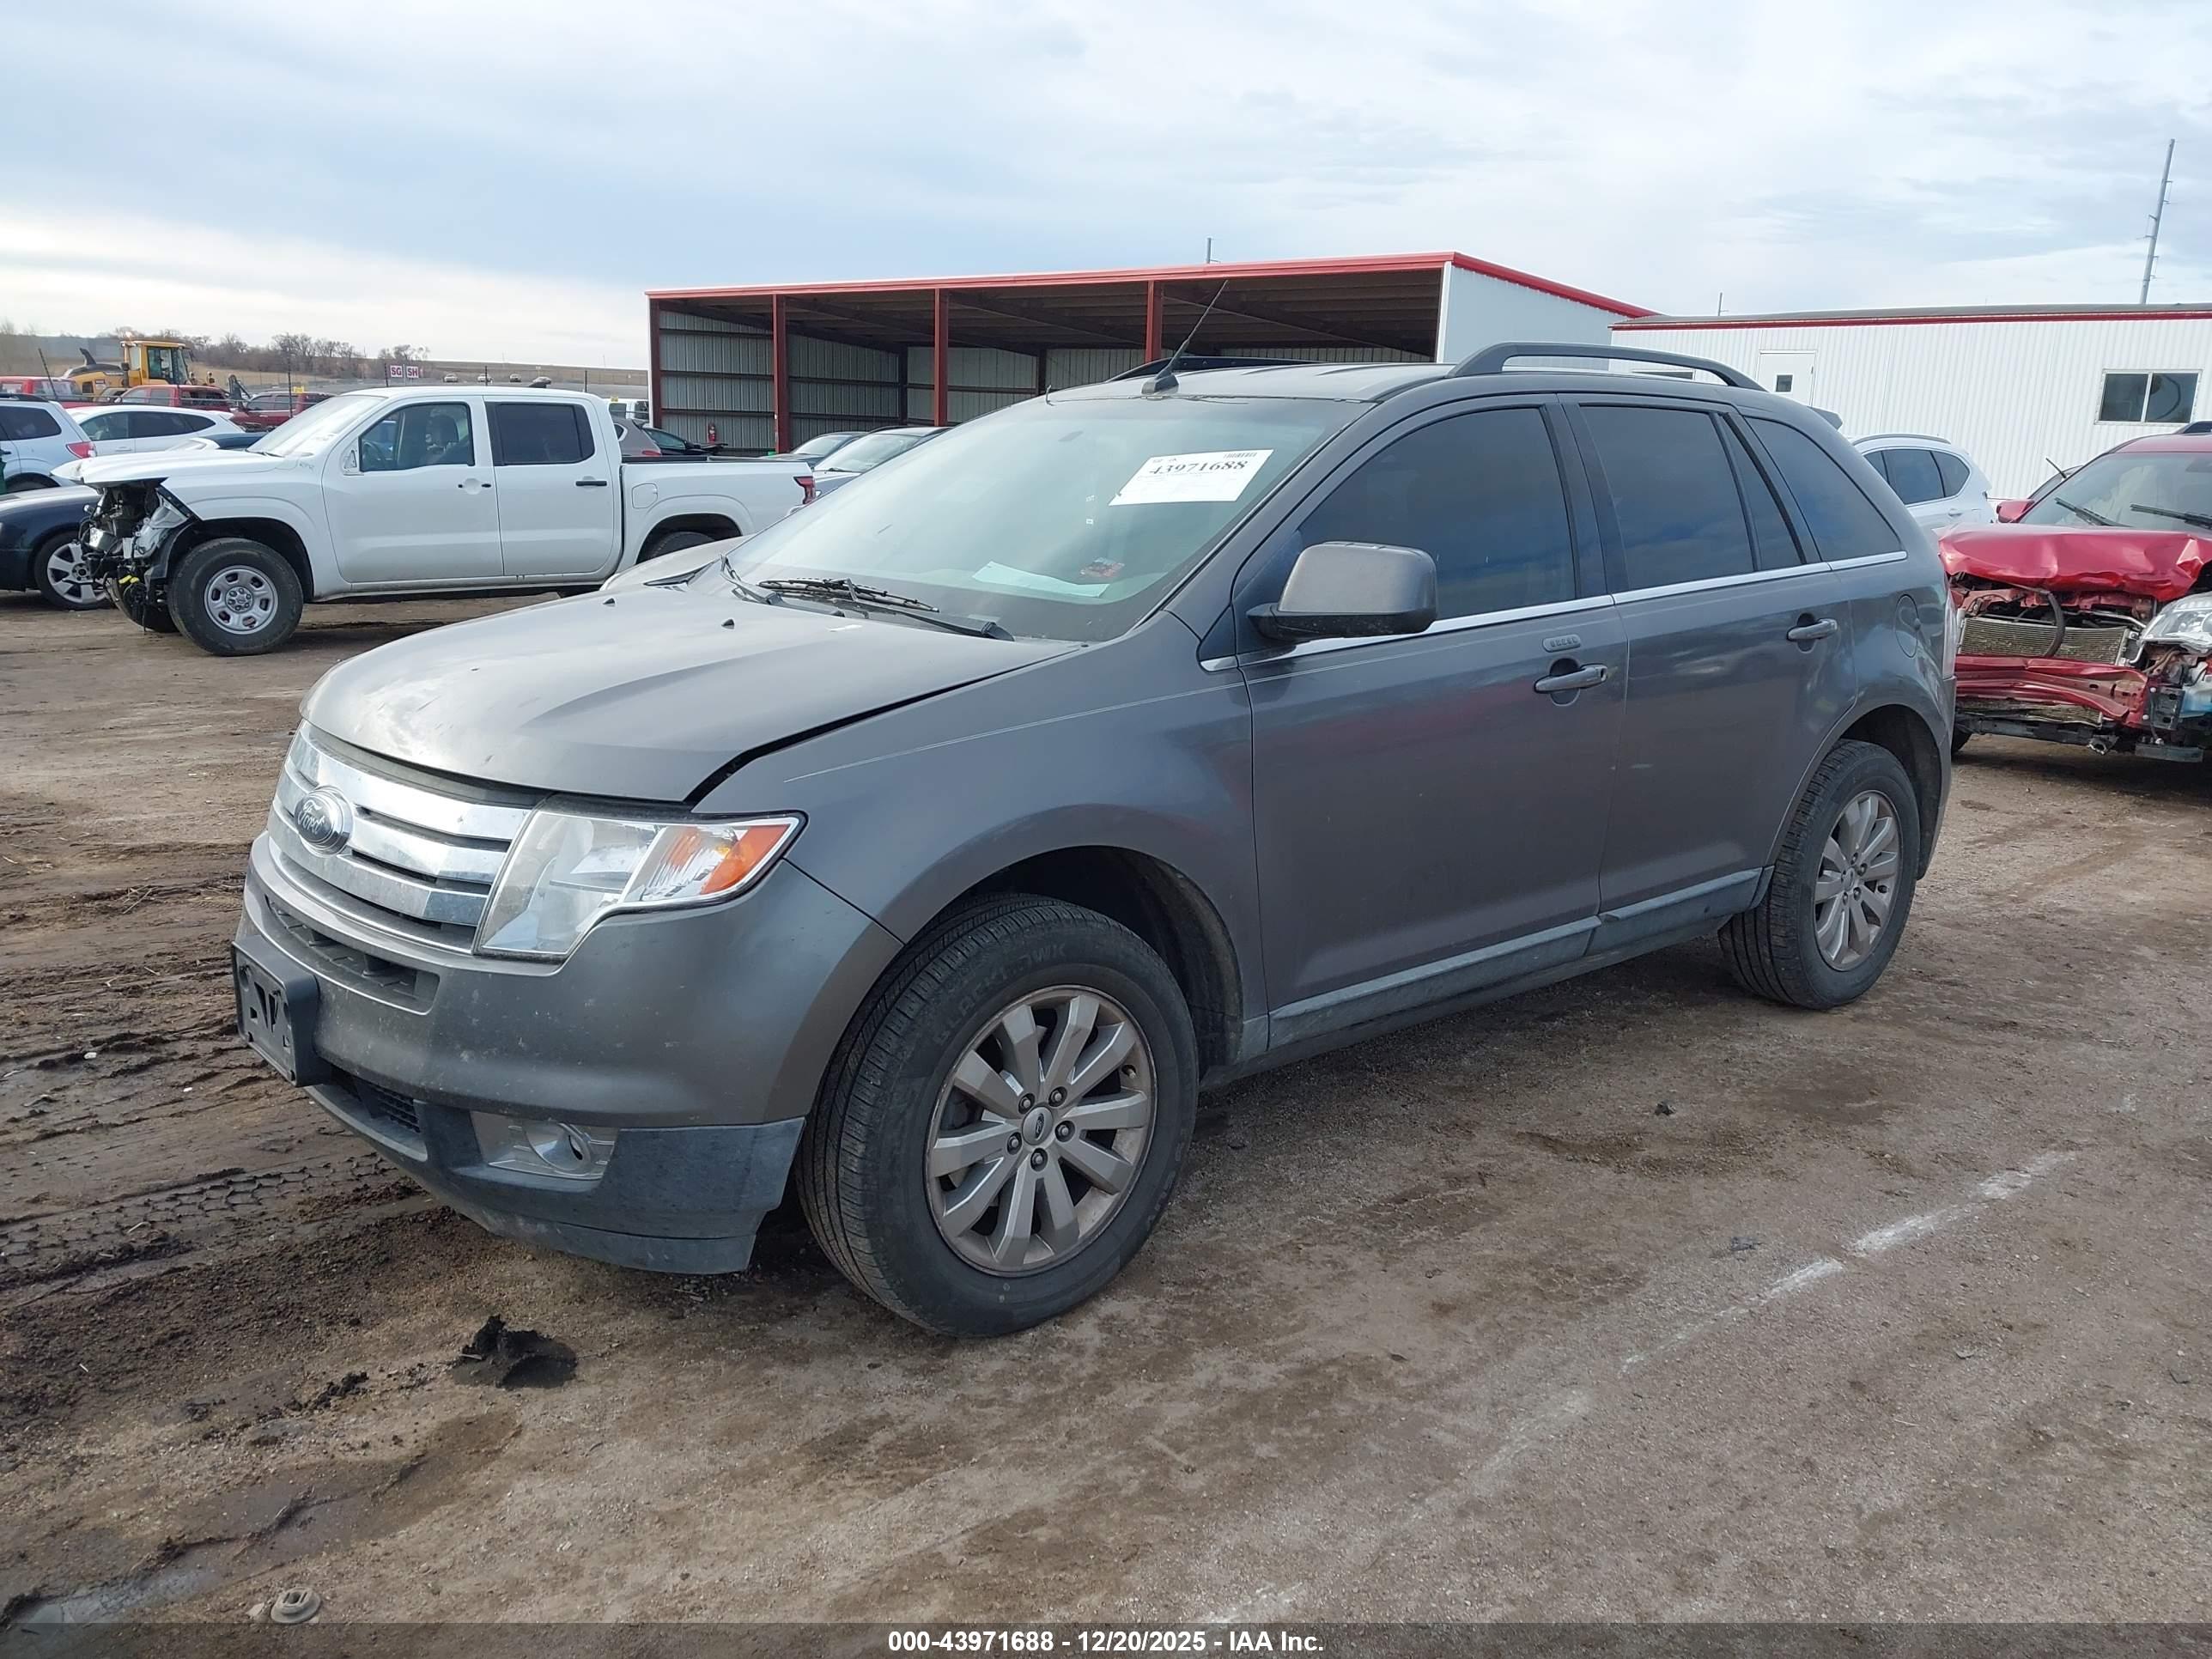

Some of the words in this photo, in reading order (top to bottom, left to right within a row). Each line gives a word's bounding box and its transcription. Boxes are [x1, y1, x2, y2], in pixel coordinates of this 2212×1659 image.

[391, 367, 402, 376] SG
[407, 368, 418, 377] SH
[1149, 459, 1249, 474] 43971688
[297, 799, 325, 835] Ford
